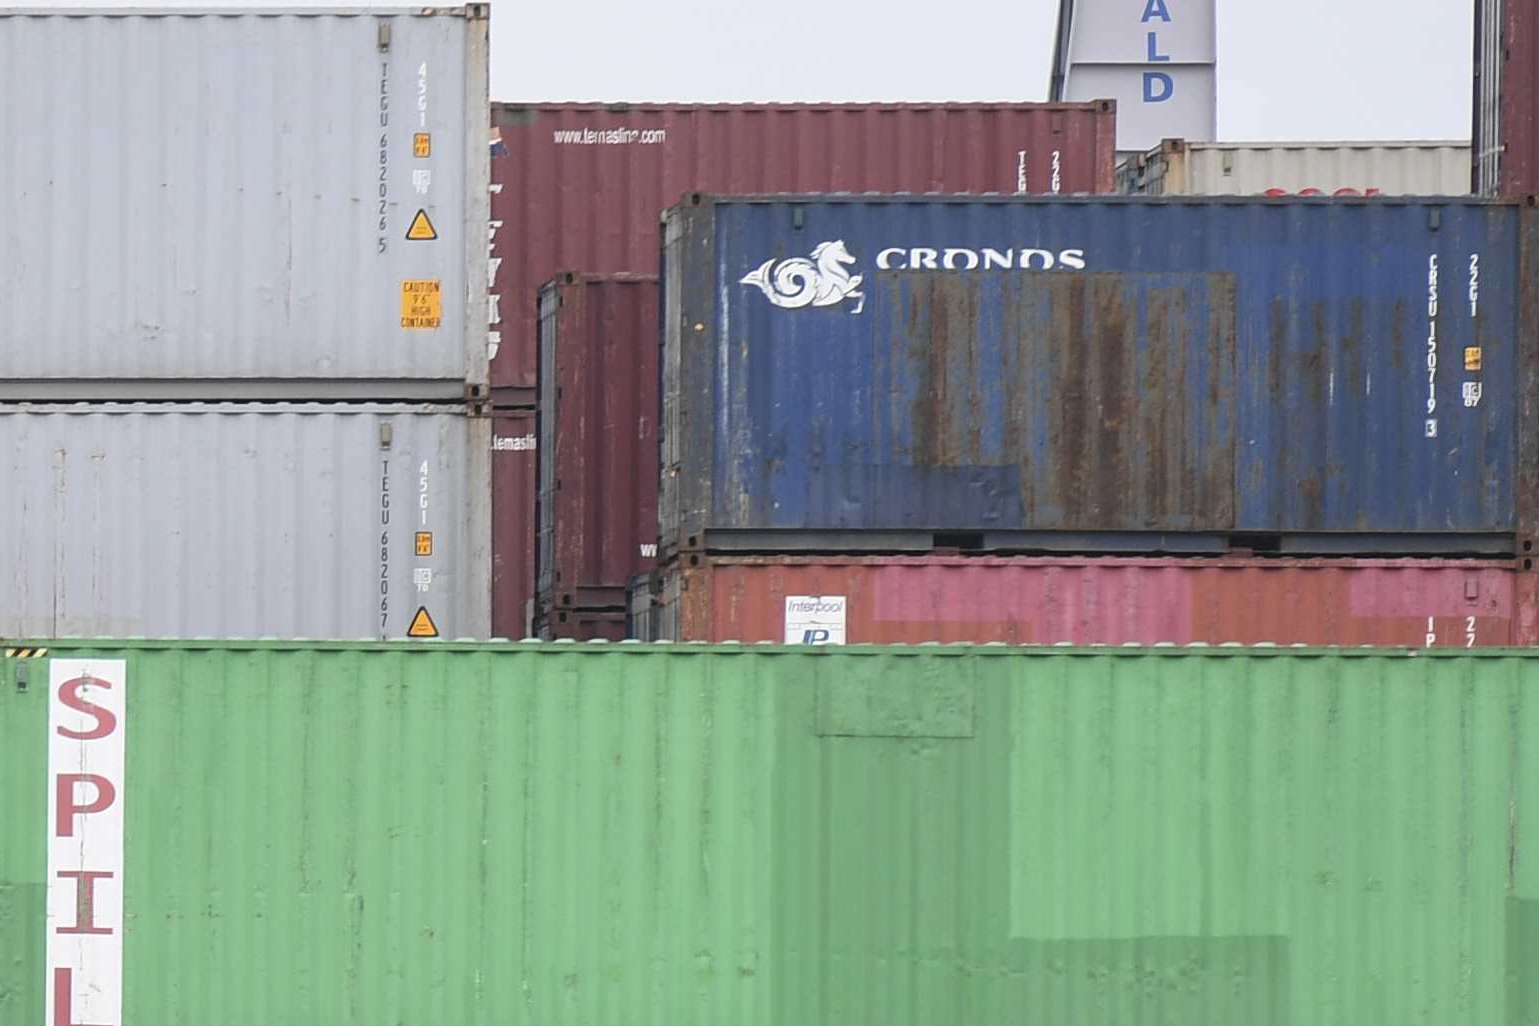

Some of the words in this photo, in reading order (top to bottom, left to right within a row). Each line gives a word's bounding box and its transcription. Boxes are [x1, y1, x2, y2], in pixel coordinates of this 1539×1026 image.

[380, 62, 389, 127] TEGU
[418, 62, 427, 127] 45G1
[554, 127, 666, 144] www.temasline.com
[379, 134, 387, 230] 682026
[1018, 151, 1027, 192] TEG
[1052, 151, 1060, 194] 22G
[378, 238, 386, 253] 5
[875, 247, 1086, 270] CRONOS
[403, 281, 439, 293] CAUTION
[411, 306, 431, 316] HIGH
[1428, 254, 1438, 317] CRSU
[1469, 254, 1478, 317] 22G1
[1427, 321, 1437, 414] 150719
[381, 461, 389, 525] TEGU
[420, 460, 428, 525] 45G1
[380, 531, 388, 628] 682067
[417, 583, 429, 592] 70
[788, 600, 843, 614] Interpool
